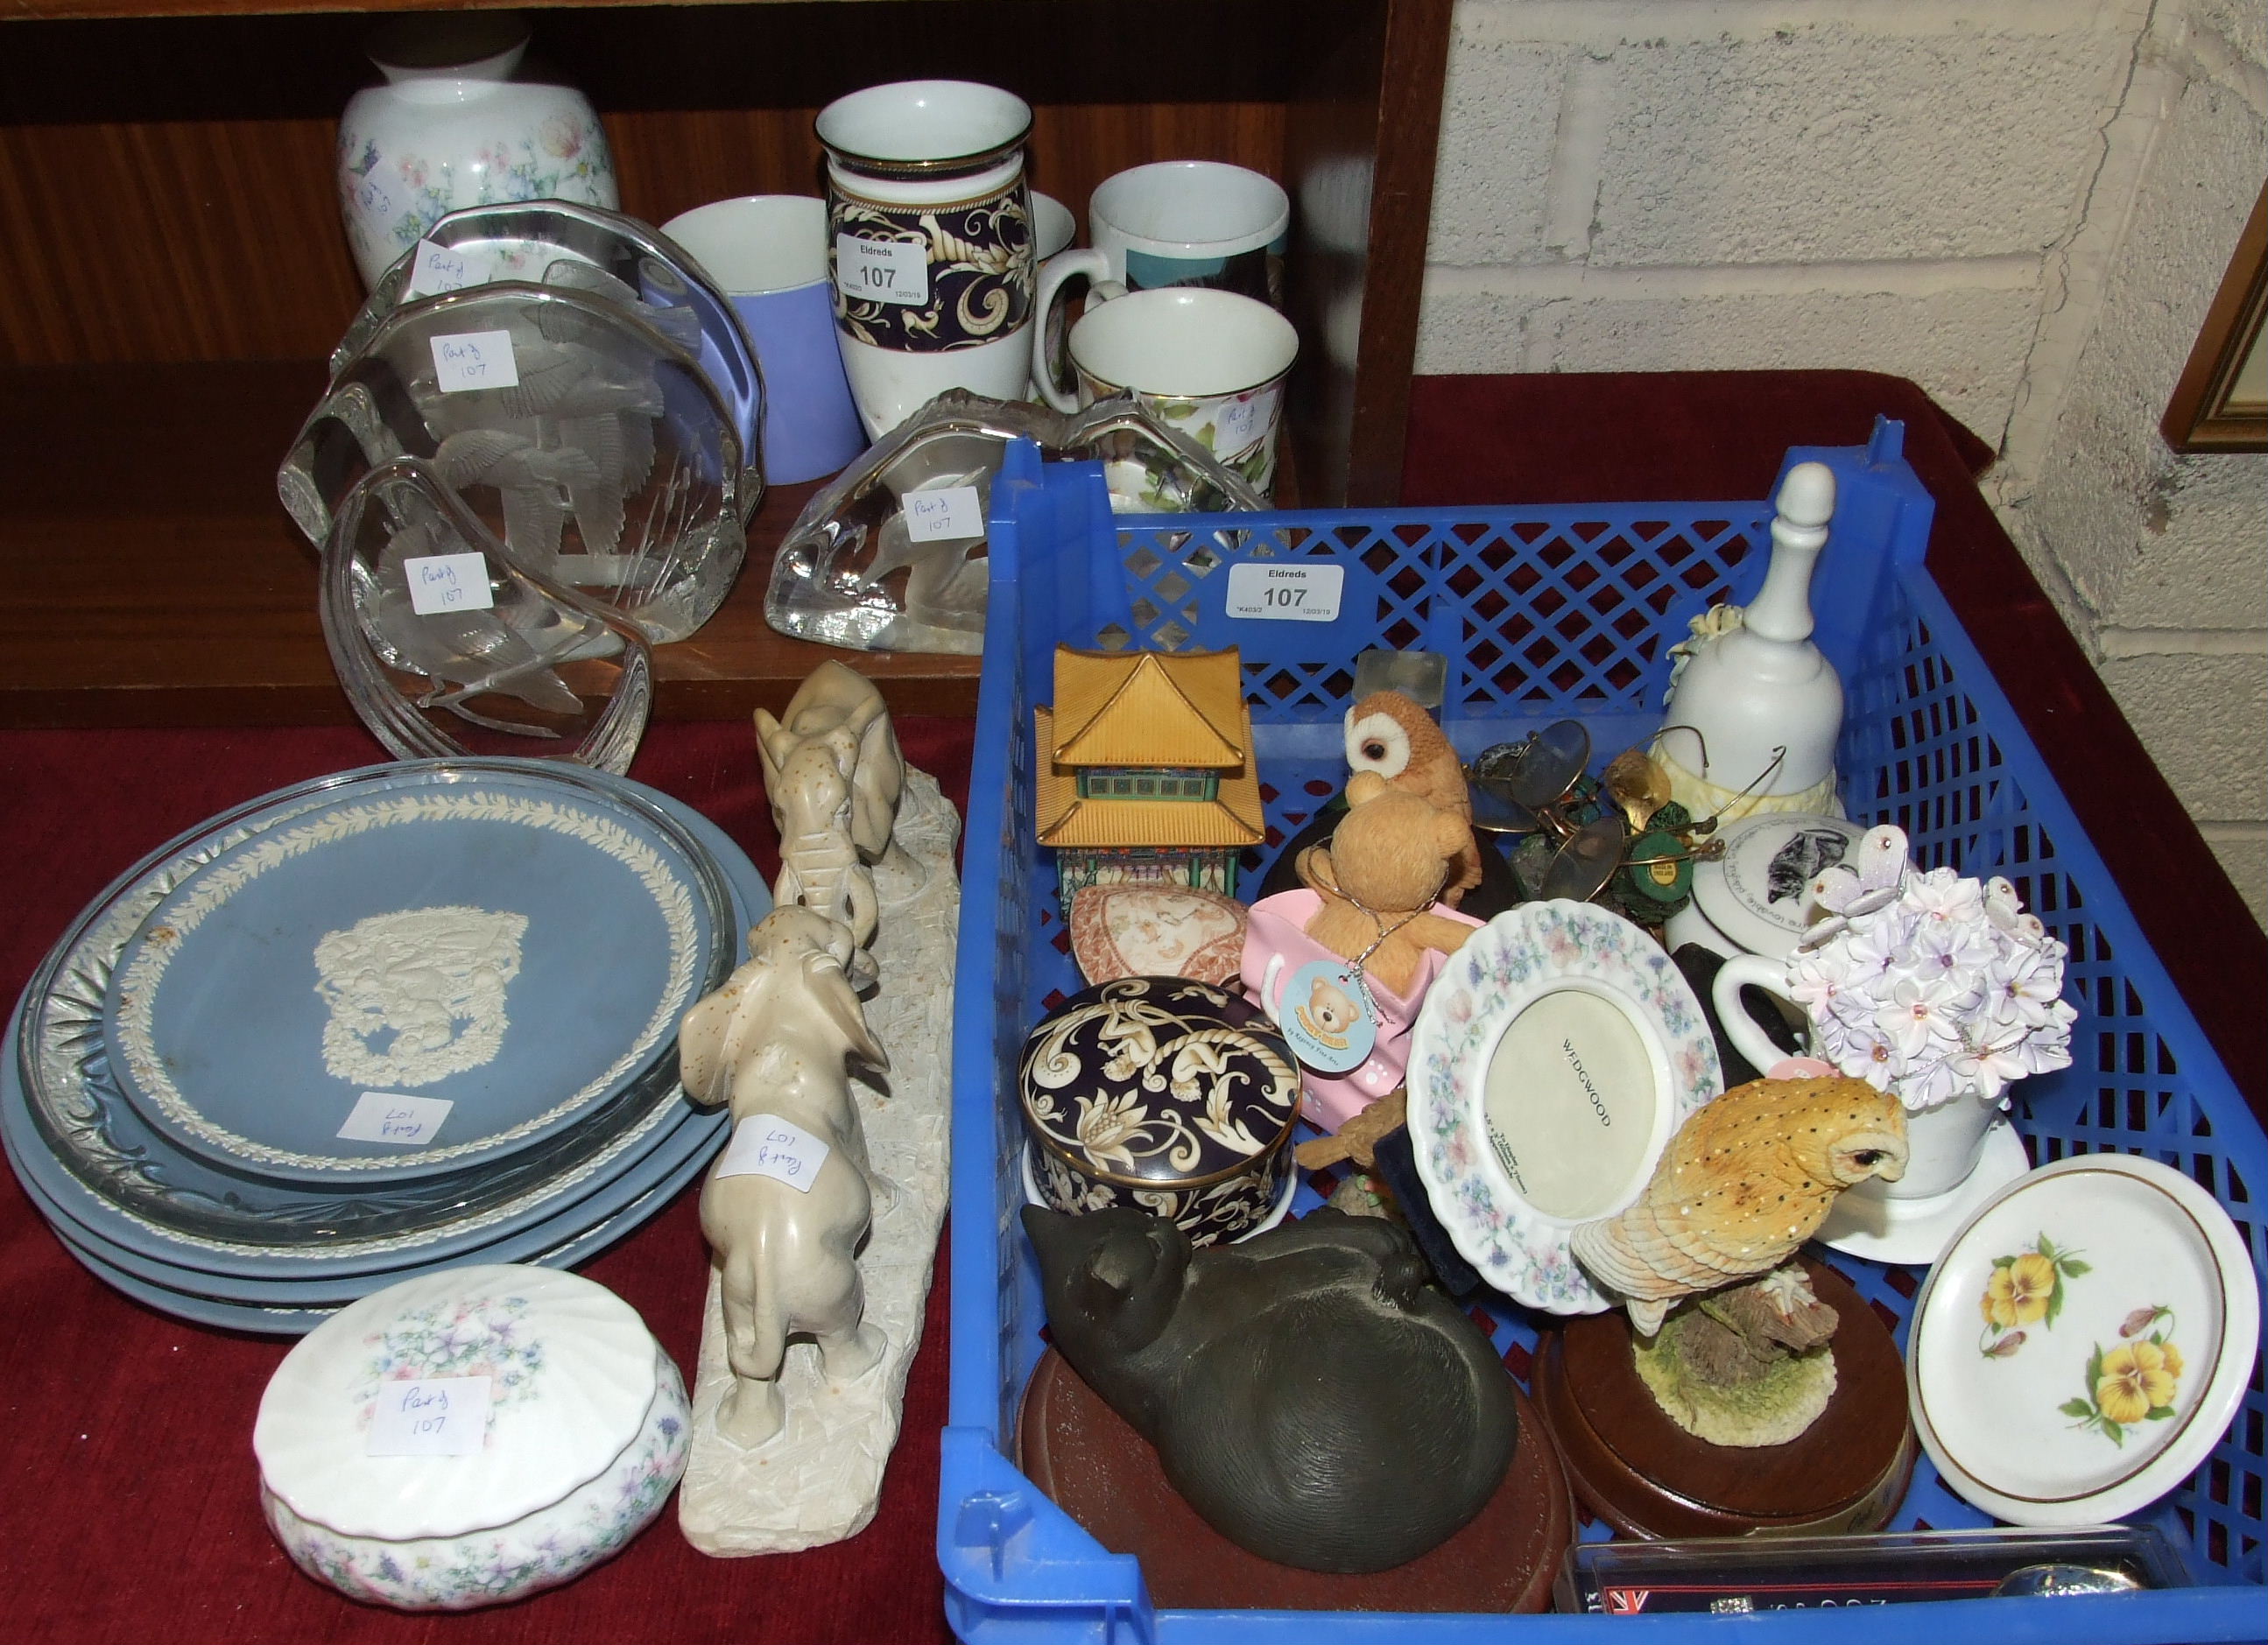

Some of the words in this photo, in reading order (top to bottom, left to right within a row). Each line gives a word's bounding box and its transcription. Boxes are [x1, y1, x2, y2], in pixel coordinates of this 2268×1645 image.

[860, 244, 892, 257] Eldreds
[428, 253, 454, 273] Part
[860, 265, 897, 289] 107
[442, 342, 466, 362] Part
[461, 363, 487, 378] 107
[1235, 418, 1253, 435] 107
[929, 517, 951, 532] 107
[1268, 569, 1307, 579] Eldreds
[440, 587, 462, 606] 107
[1264, 587, 1307, 607] 107
[1563, 1038, 1610, 1127] WEDGWOOD
[385, 1109, 414, 1119] 107
[766, 1129, 795, 1147] 107
[401, 1386, 436, 1412] Part
[412, 1416, 446, 1435] 107
